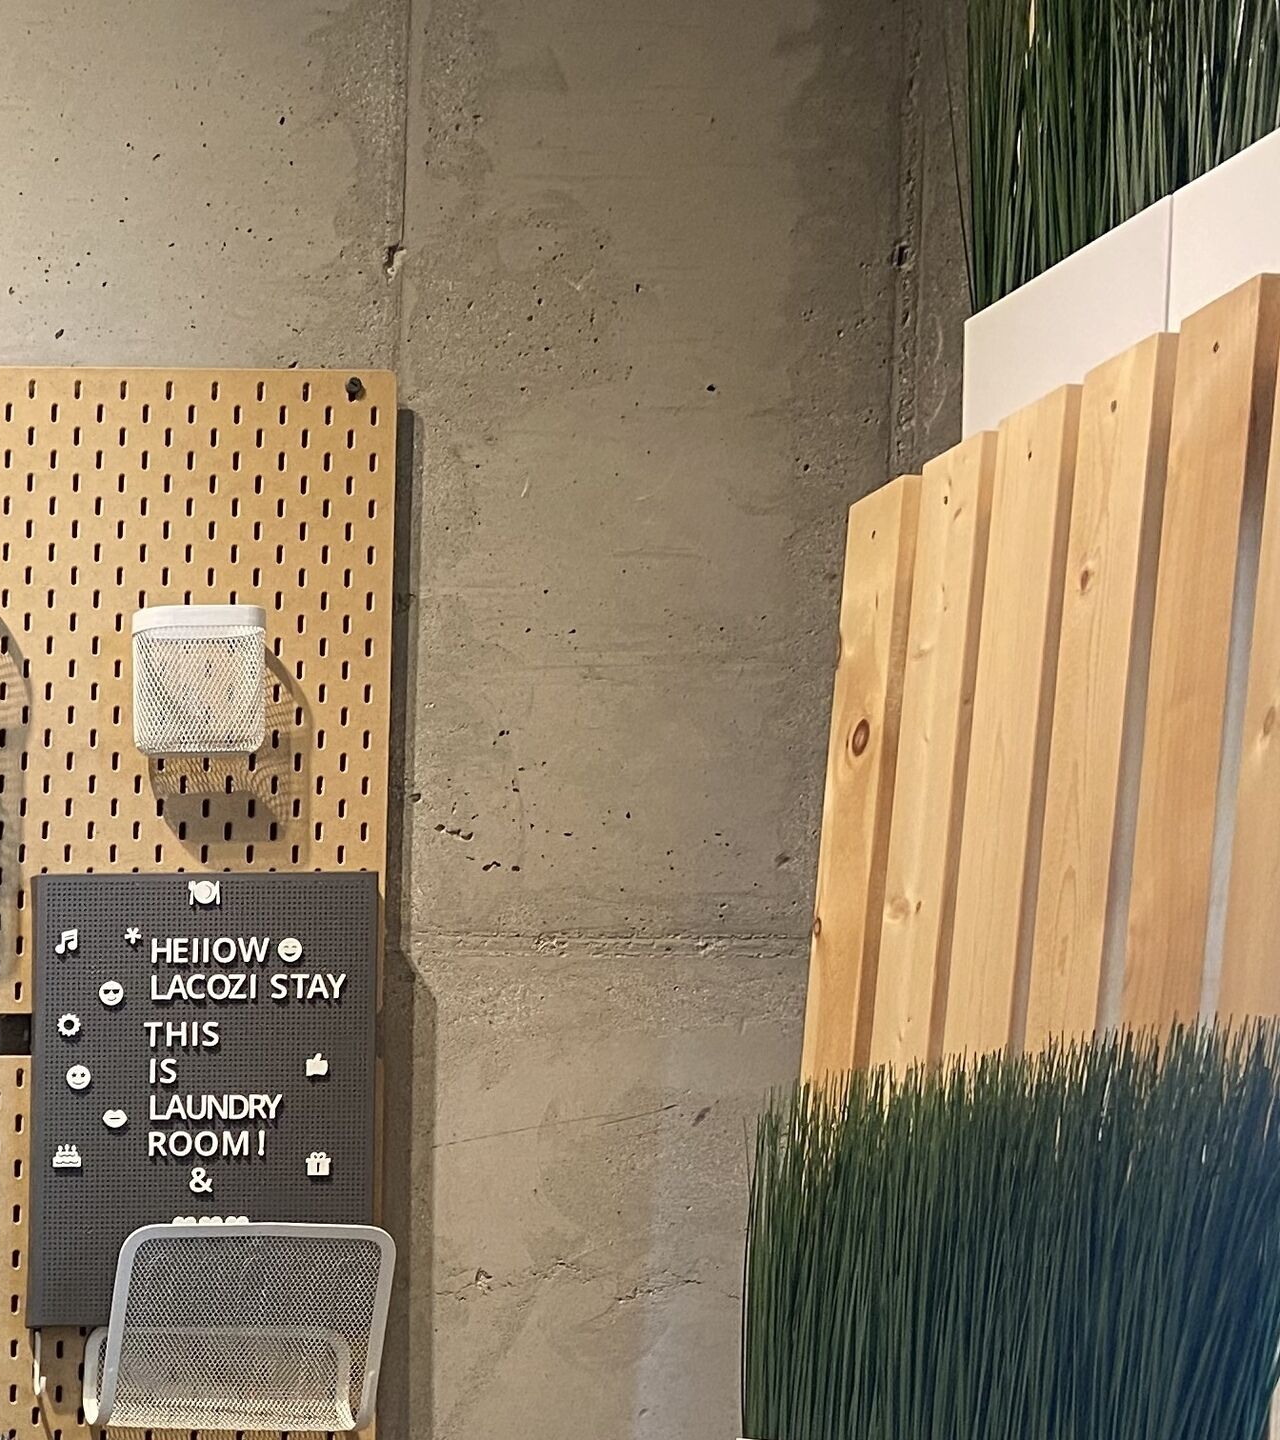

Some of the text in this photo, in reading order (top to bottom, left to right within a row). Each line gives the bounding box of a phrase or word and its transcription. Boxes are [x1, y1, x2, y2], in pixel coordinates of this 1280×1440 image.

[151, 973, 347, 1000] LACOZI STAY
[143, 1021, 220, 1047] THIS
[149, 1058, 177, 1084] IS
[149, 1094, 283, 1120] LAUNDRY
[189, 1167, 213, 1193] &
